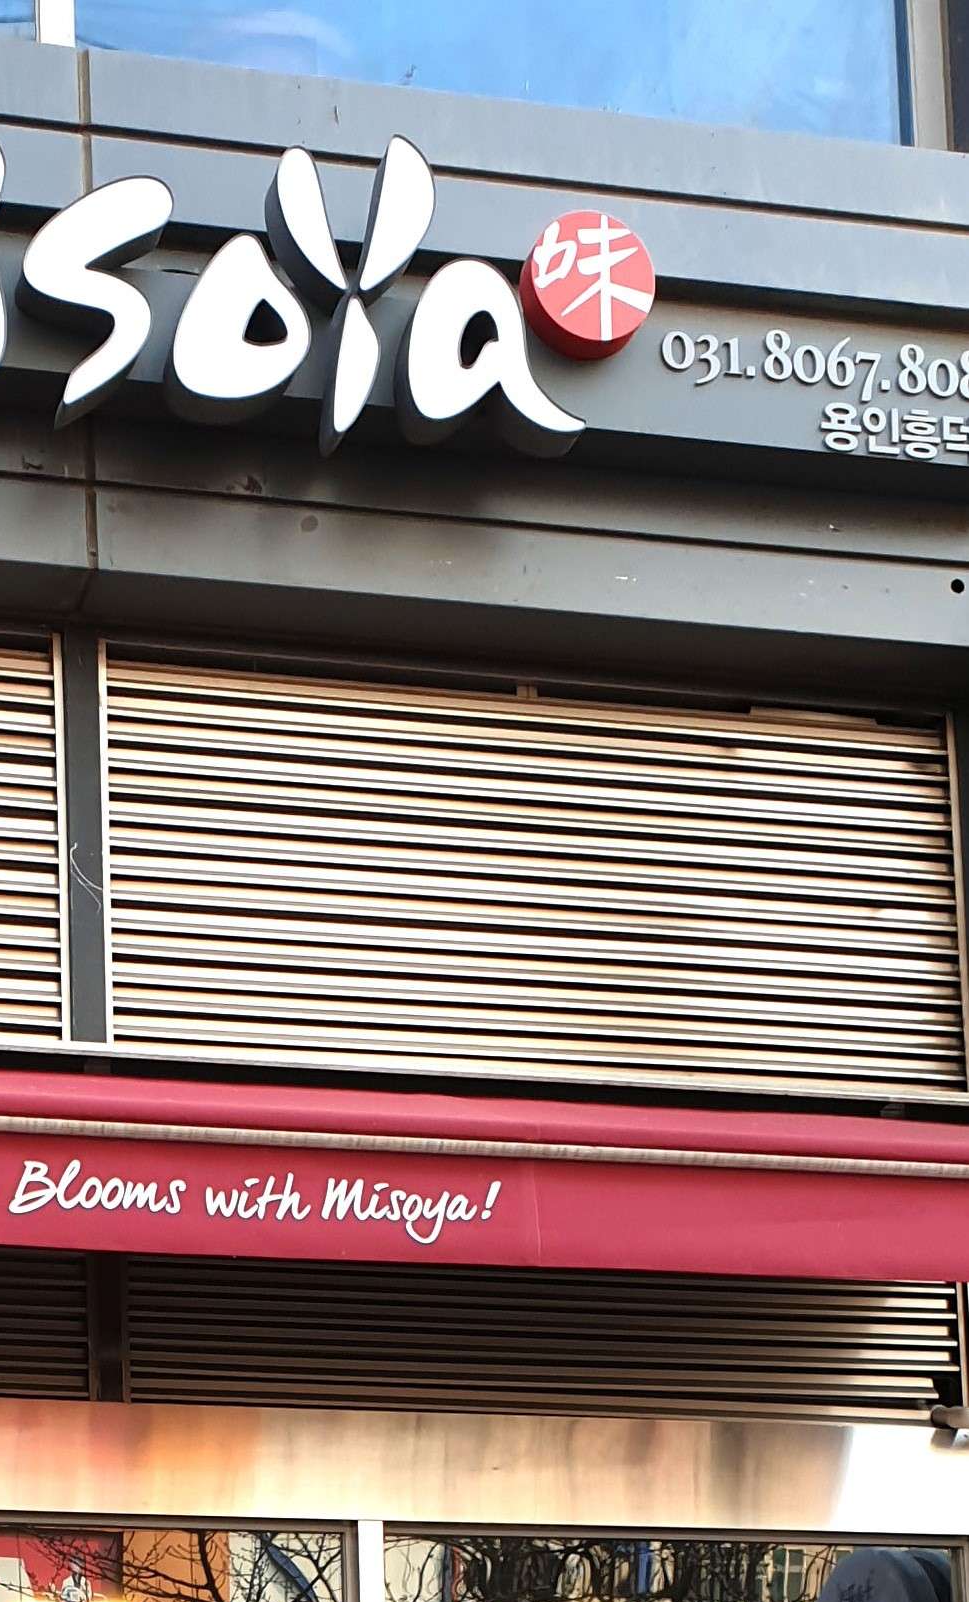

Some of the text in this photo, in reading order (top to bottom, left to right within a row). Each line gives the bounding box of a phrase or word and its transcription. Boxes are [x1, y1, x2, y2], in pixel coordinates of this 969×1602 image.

[8, 1159, 187, 1215] Blooms
[205, 1171, 312, 1222] with
[320, 1178, 503, 1245] Misoya!
